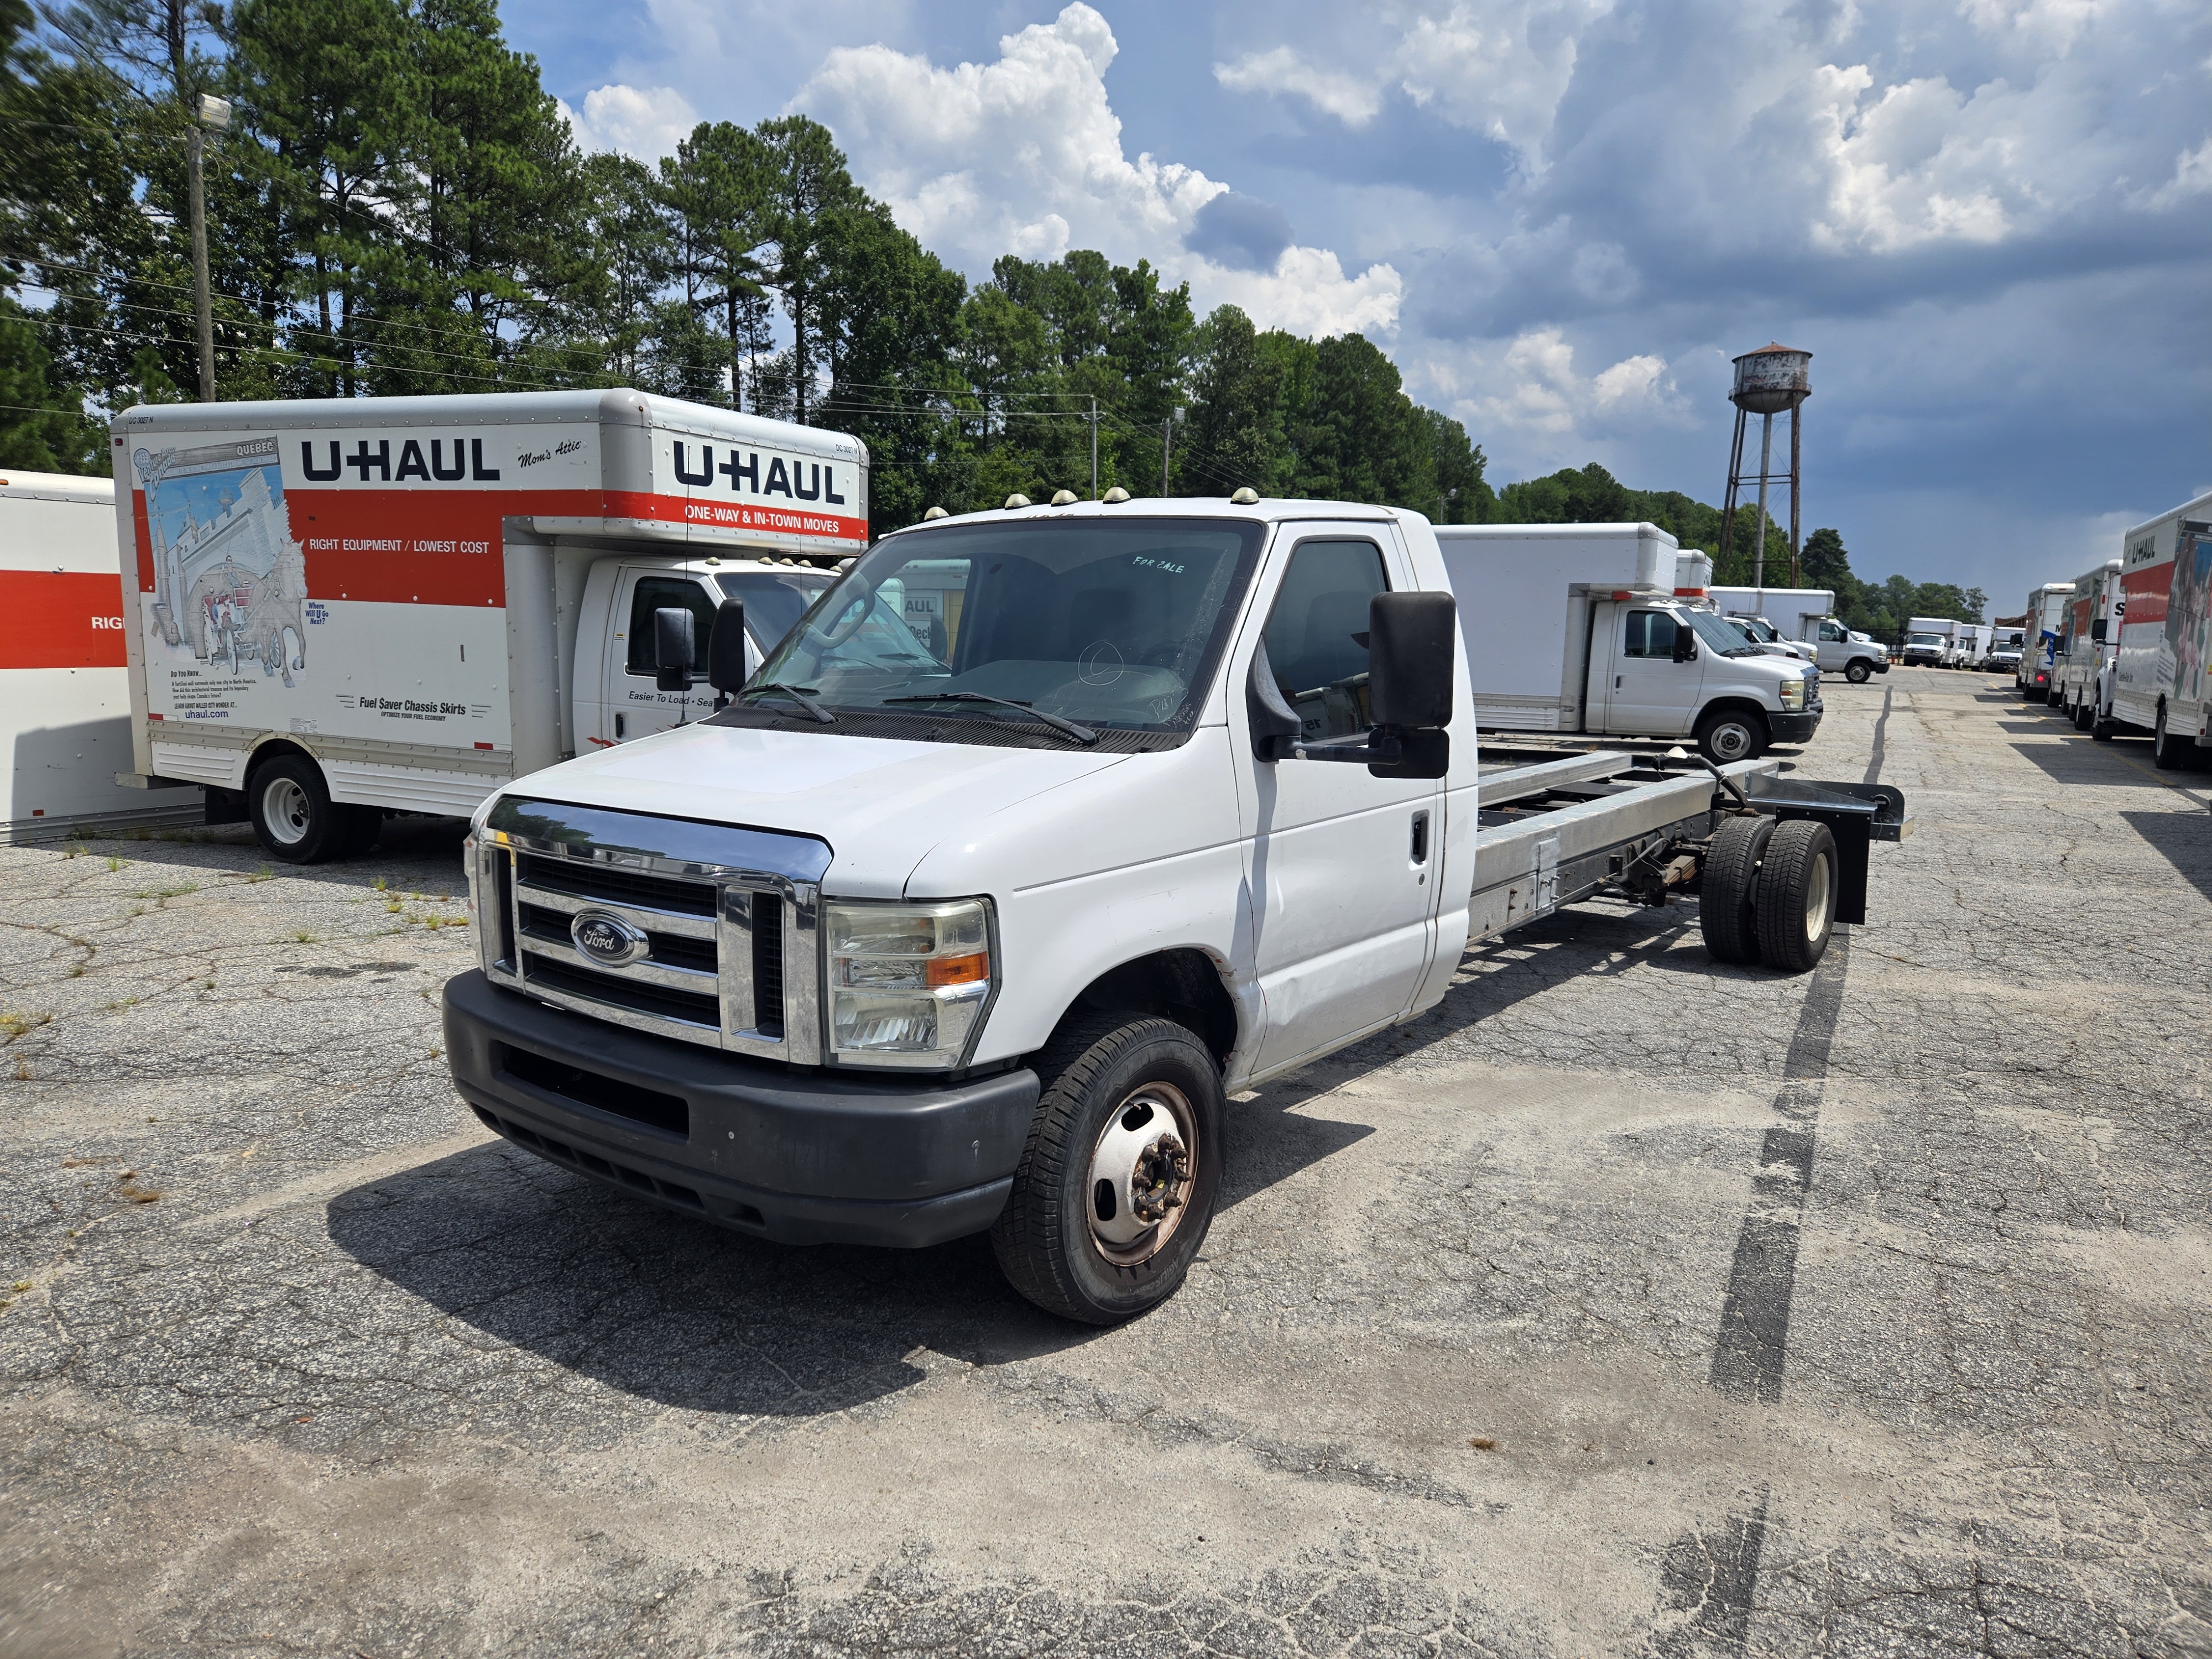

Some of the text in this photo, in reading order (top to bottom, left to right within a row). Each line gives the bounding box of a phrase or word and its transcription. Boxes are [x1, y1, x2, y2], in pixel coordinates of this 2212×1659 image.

[237, 442, 274, 456] QUÉBEC
[518, 441, 580, 468] Mom's Attic
[138, 453, 161, 484] Venture
[301, 439, 500, 481] U-HAUL
[149, 453, 175, 503] Canada
[674, 440, 845, 505] U-HAUL
[685, 505, 839, 533] ONE-WAY & IN-TOWN MOVES
[310, 539, 489, 554] RIGHT EQUIPMENT / LOWEST COST
[2132, 535, 2155, 564] U-HAUL
[1133, 556, 1155, 566] FOR
[316, 610, 321, 619] U
[904, 600, 934, 613] AUL
[91, 617, 125, 629] RIG
[359, 697, 466, 715] Fuel $aver Chassis Skirts
[629, 691, 713, 707] Easier To Load Sea
[185, 709, 228, 718] uhaul.com
[584, 925, 614, 950] Ford
